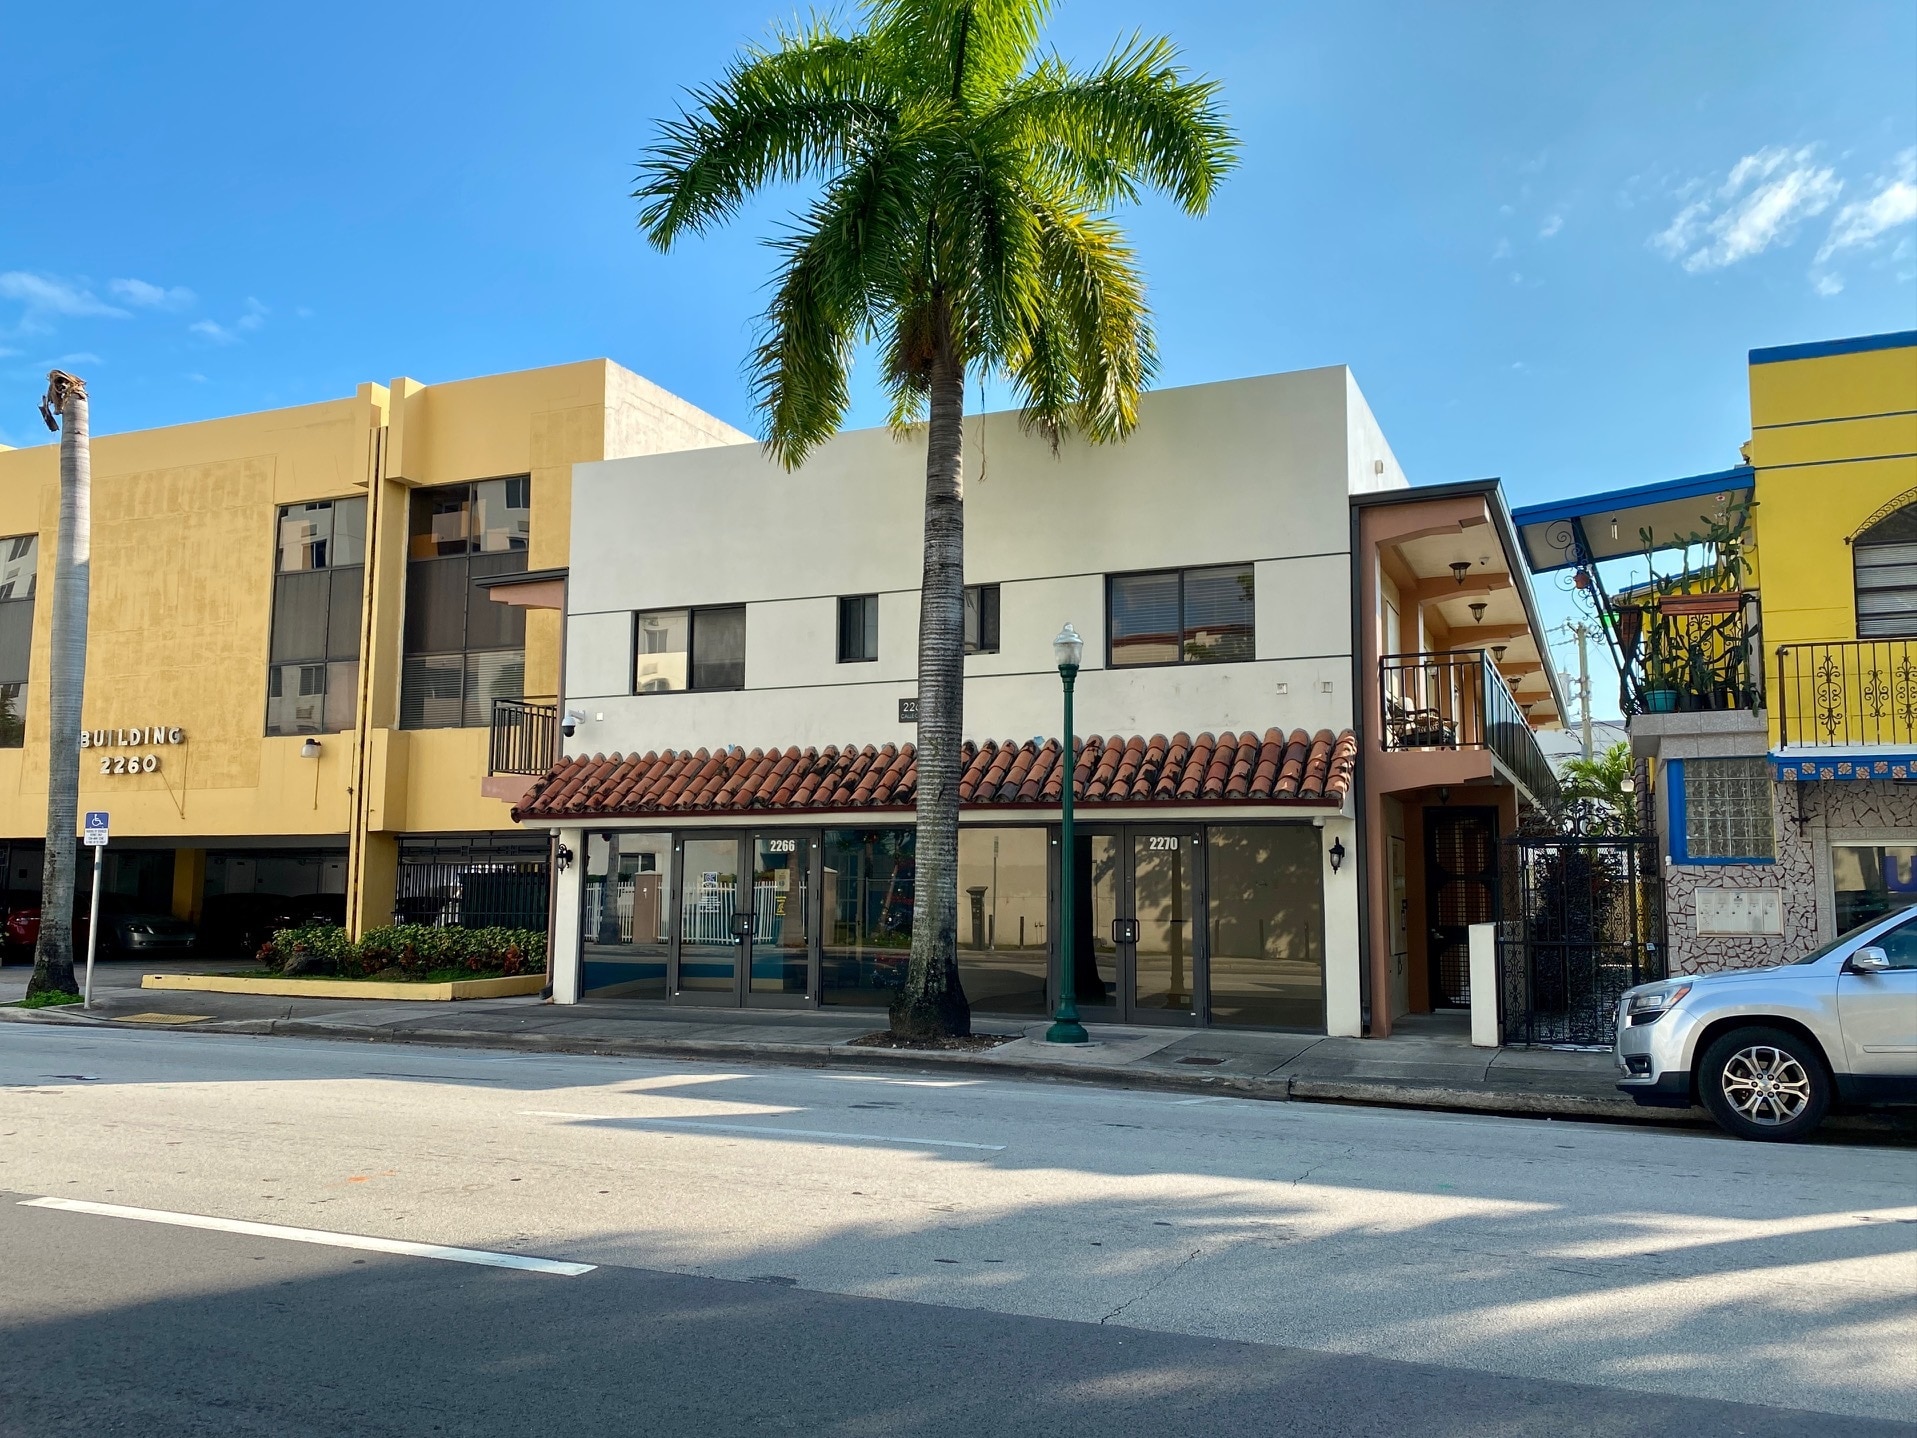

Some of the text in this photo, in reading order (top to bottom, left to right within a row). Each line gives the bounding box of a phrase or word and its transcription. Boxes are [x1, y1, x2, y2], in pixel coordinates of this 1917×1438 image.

[80, 726, 182, 748] BUILDING
[99, 754, 157, 774] 2260
[769, 839, 796, 852] 2266
[1149, 836, 1178, 850] 2270
